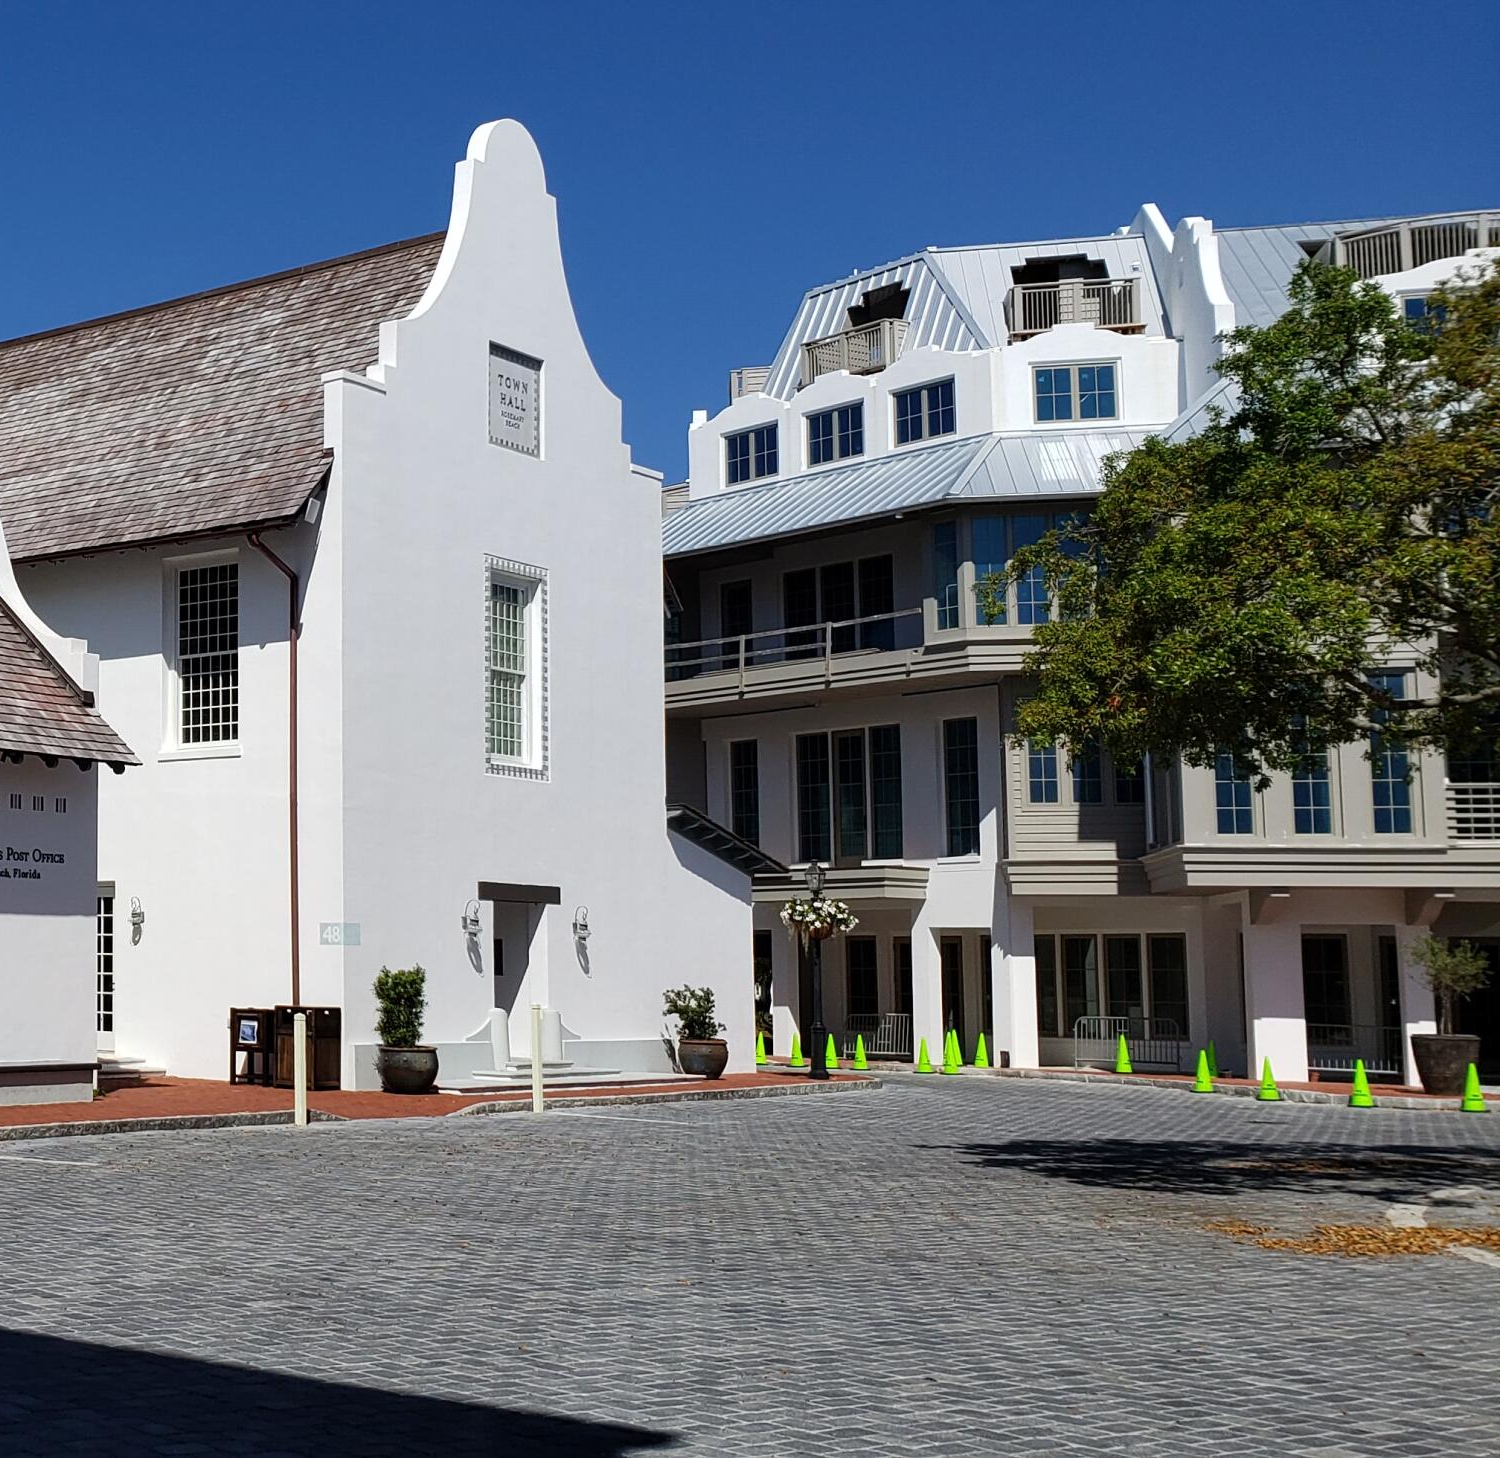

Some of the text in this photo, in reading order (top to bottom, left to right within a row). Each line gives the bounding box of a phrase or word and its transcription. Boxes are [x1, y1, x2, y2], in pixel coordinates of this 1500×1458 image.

[498, 374, 528, 394] TOWN
[500, 392, 526, 412] HALL
[6, 846, 30, 862] POST
[32, 848, 65, 864] OFFICE
[13, 868, 41, 879] Florida
[323, 926, 340, 942] 48
